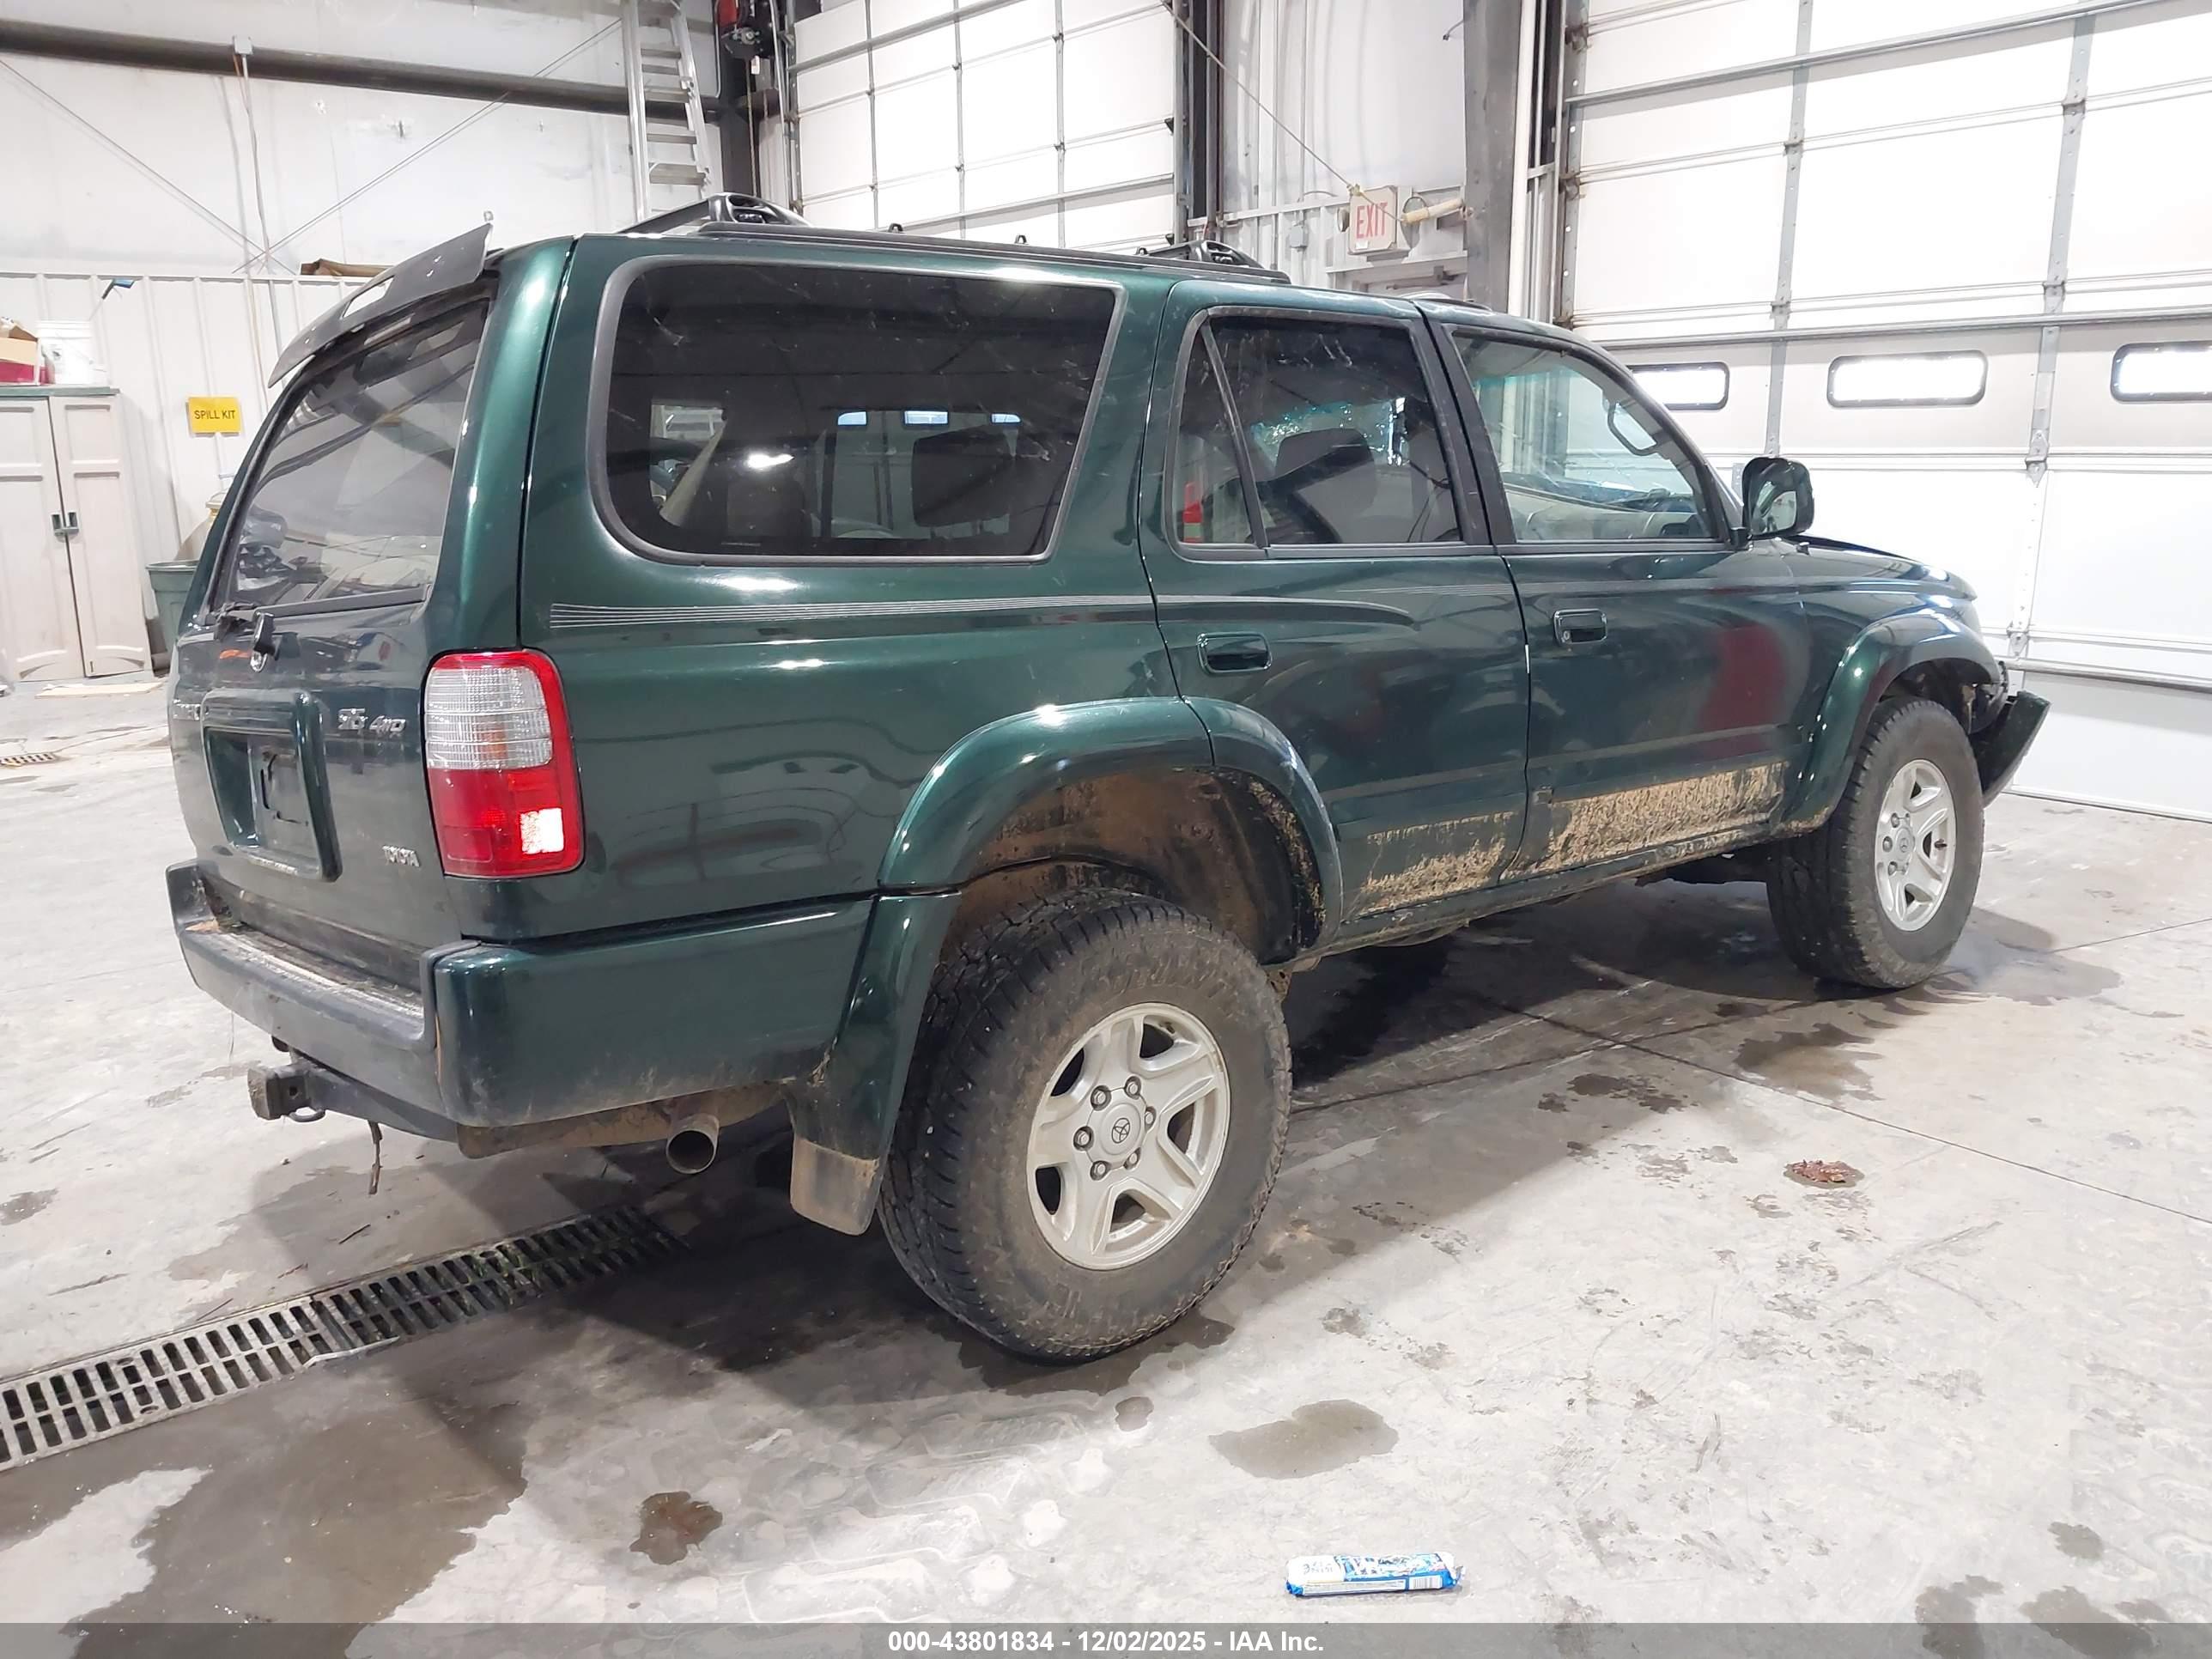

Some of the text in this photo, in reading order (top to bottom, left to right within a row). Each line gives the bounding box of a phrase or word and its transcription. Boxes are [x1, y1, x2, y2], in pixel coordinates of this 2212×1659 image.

[1357, 202, 1388, 238] EXIT
[194, 410, 235, 419] SPILL KIT
